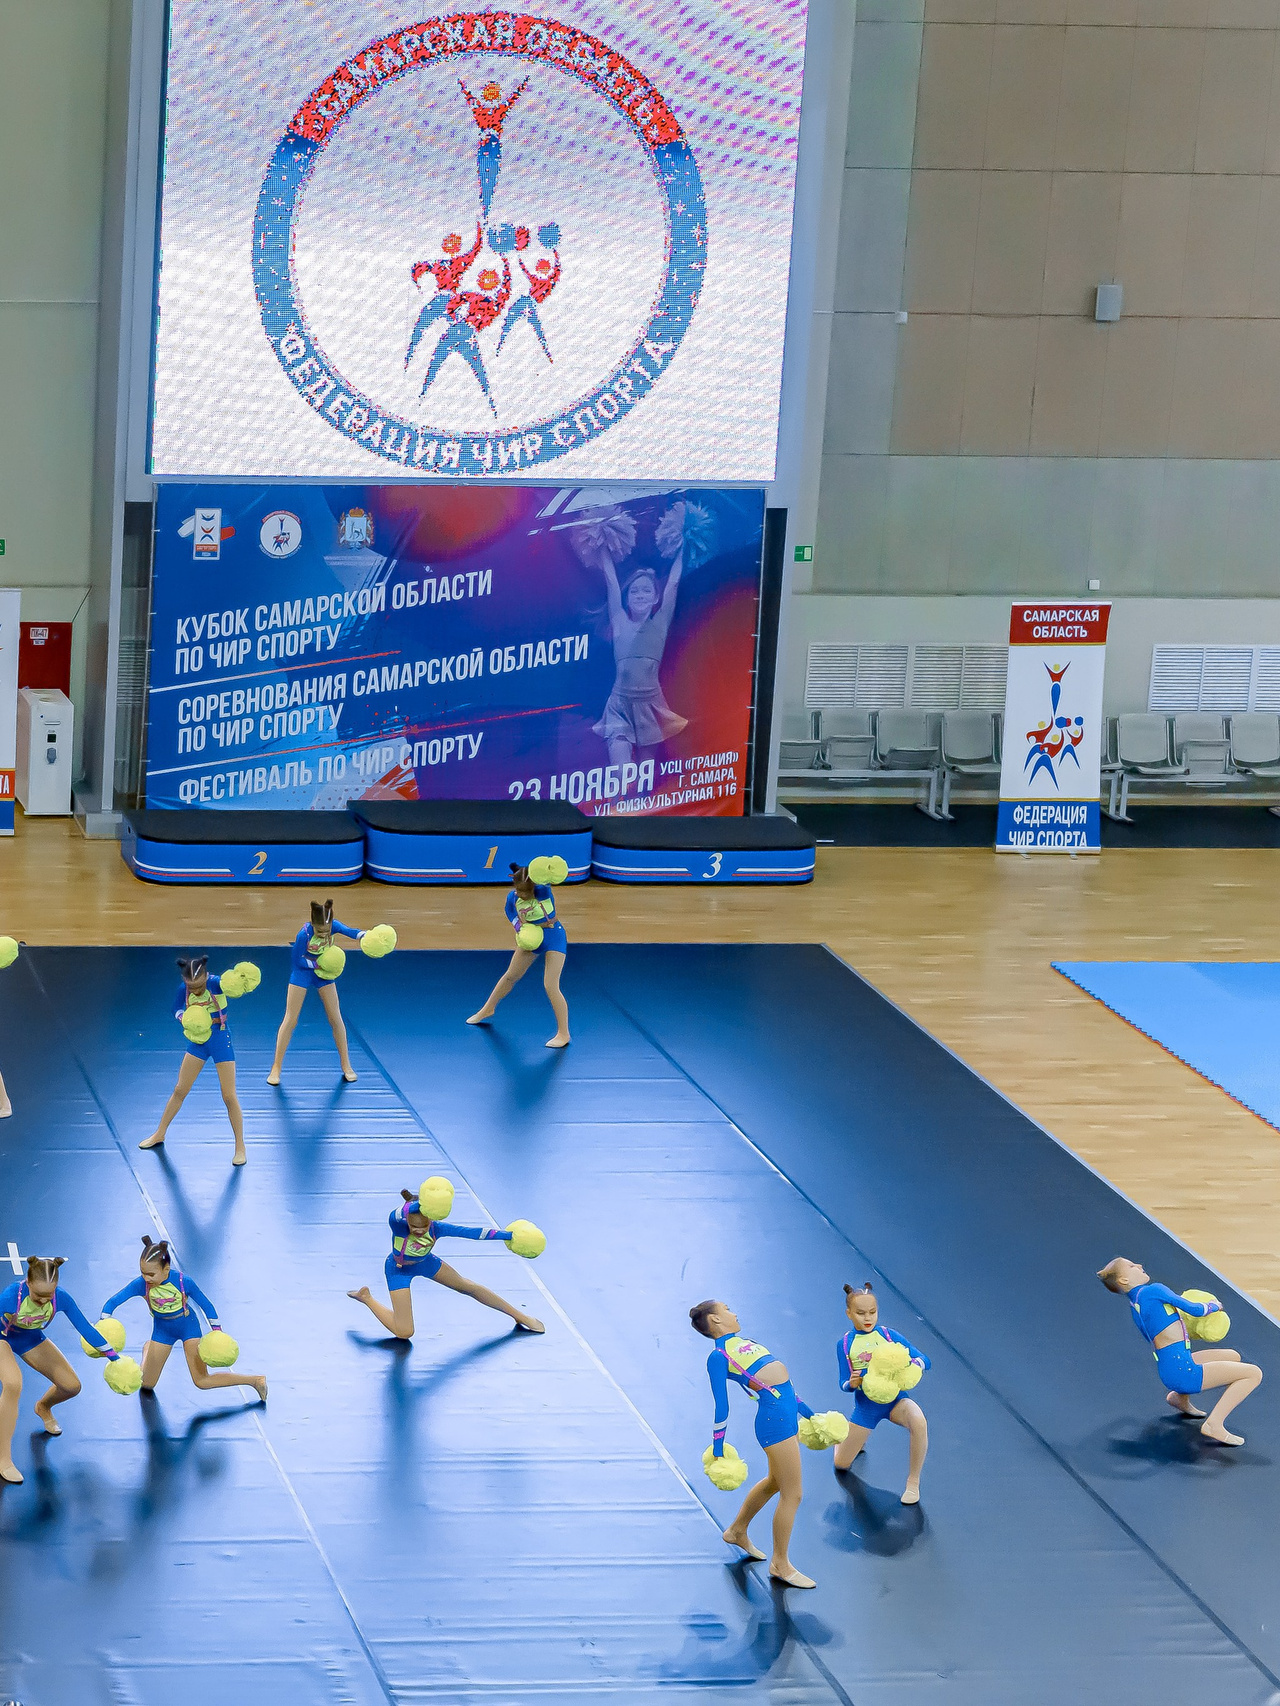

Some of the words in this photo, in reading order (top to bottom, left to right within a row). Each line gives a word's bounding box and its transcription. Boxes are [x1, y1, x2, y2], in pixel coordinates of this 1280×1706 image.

[279, 328, 461, 470] ФЕДЕРАЦИЯ
[472, 433, 543, 470] ЧИР
[552, 338, 677, 447] СПОРТА
[176, 608, 249, 644] КУБОК
[255, 582, 386, 631] САМАРСКОЙ
[392, 569, 493, 609] ОБЛАСТИ
[1023, 609, 1100, 623] САМАРСКАЯ
[1032, 625, 1088, 638] ОБЛАСТЬ
[174, 645, 203, 674] ПО
[209, 638, 252, 668] ЧИР
[256, 623, 342, 661] СПОРТУ
[177, 673, 347, 724] СОРЕВНОВАНИЯ
[352, 649, 483, 696] САМАРСКОЙ
[489, 634, 589, 674] ОБЛАСТИ
[177, 725, 206, 754] ПО
[211, 717, 254, 749] ЧИР
[259, 703, 344, 741] СПОРТУ
[178, 761, 312, 804] ФЕСТИВАЛЬ
[318, 755, 346, 782] ПО
[351, 746, 394, 777] ЧИР
[400, 732, 483, 767] СПОРТУ
[660, 760, 682, 776] УСЦ
[685, 751, 739, 770] «ГРАЦИЯ»
[508, 778, 542, 800] 23
[549, 759, 655, 804] НОЯБРЯ
[678, 774, 688, 788] Г.
[690, 767, 738, 786] САМАРА,
[594, 802, 612, 816] УЛ.
[718, 782, 737, 798] 116
[1013, 805, 1087, 827] ФЕДЕРАЦИЯ
[1008, 831, 1034, 847] ЧИР
[1037, 830, 1087, 847] СПОРТА
[247, 852, 267, 875] 2
[482, 846, 499, 869] 1
[702, 853, 723, 878] 3
